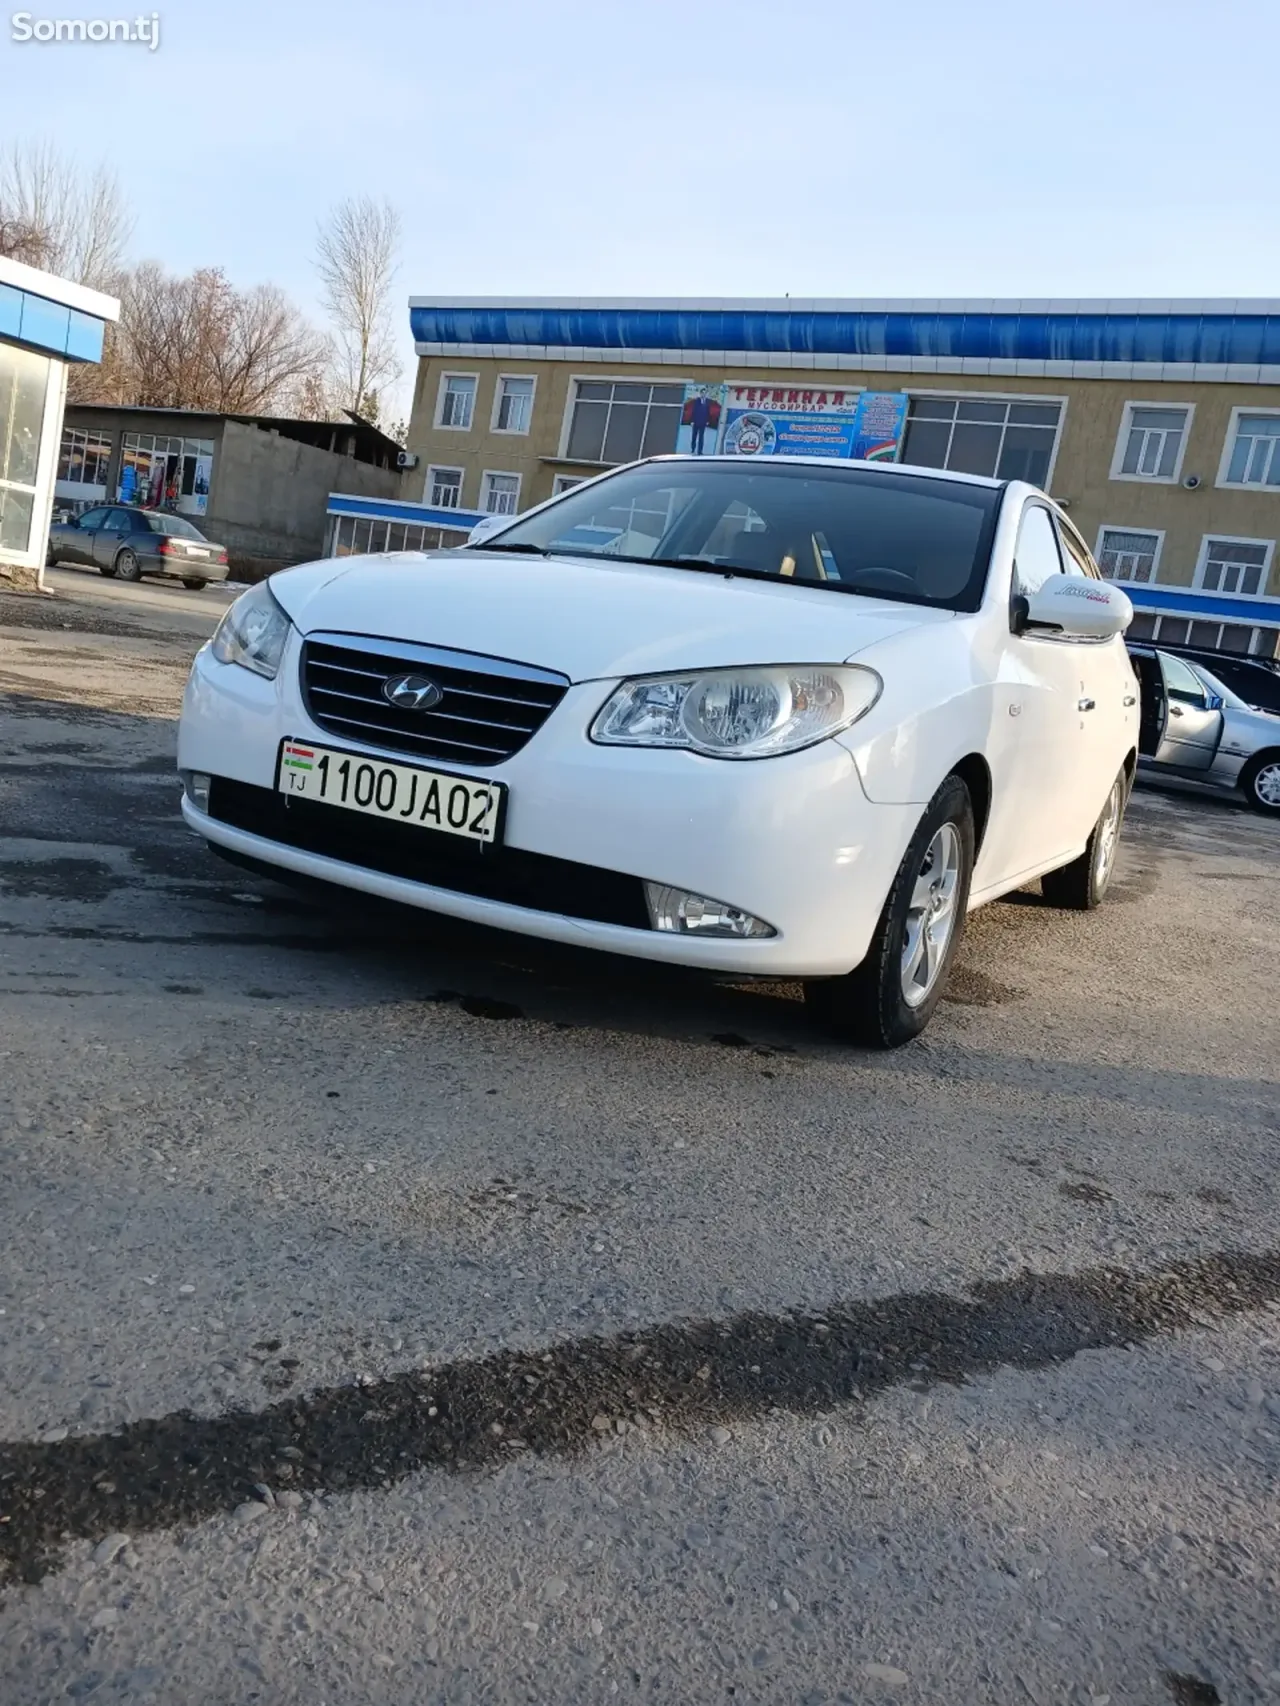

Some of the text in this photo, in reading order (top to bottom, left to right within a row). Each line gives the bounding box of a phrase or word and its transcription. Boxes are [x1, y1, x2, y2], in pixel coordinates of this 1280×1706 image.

[735, 388, 845, 405] ТЕРМИНАЛ
[748, 400, 825, 413] МУСОФИРБАР
[289, 773, 306, 791] TJ
[318, 755, 493, 835] 1100JA02
